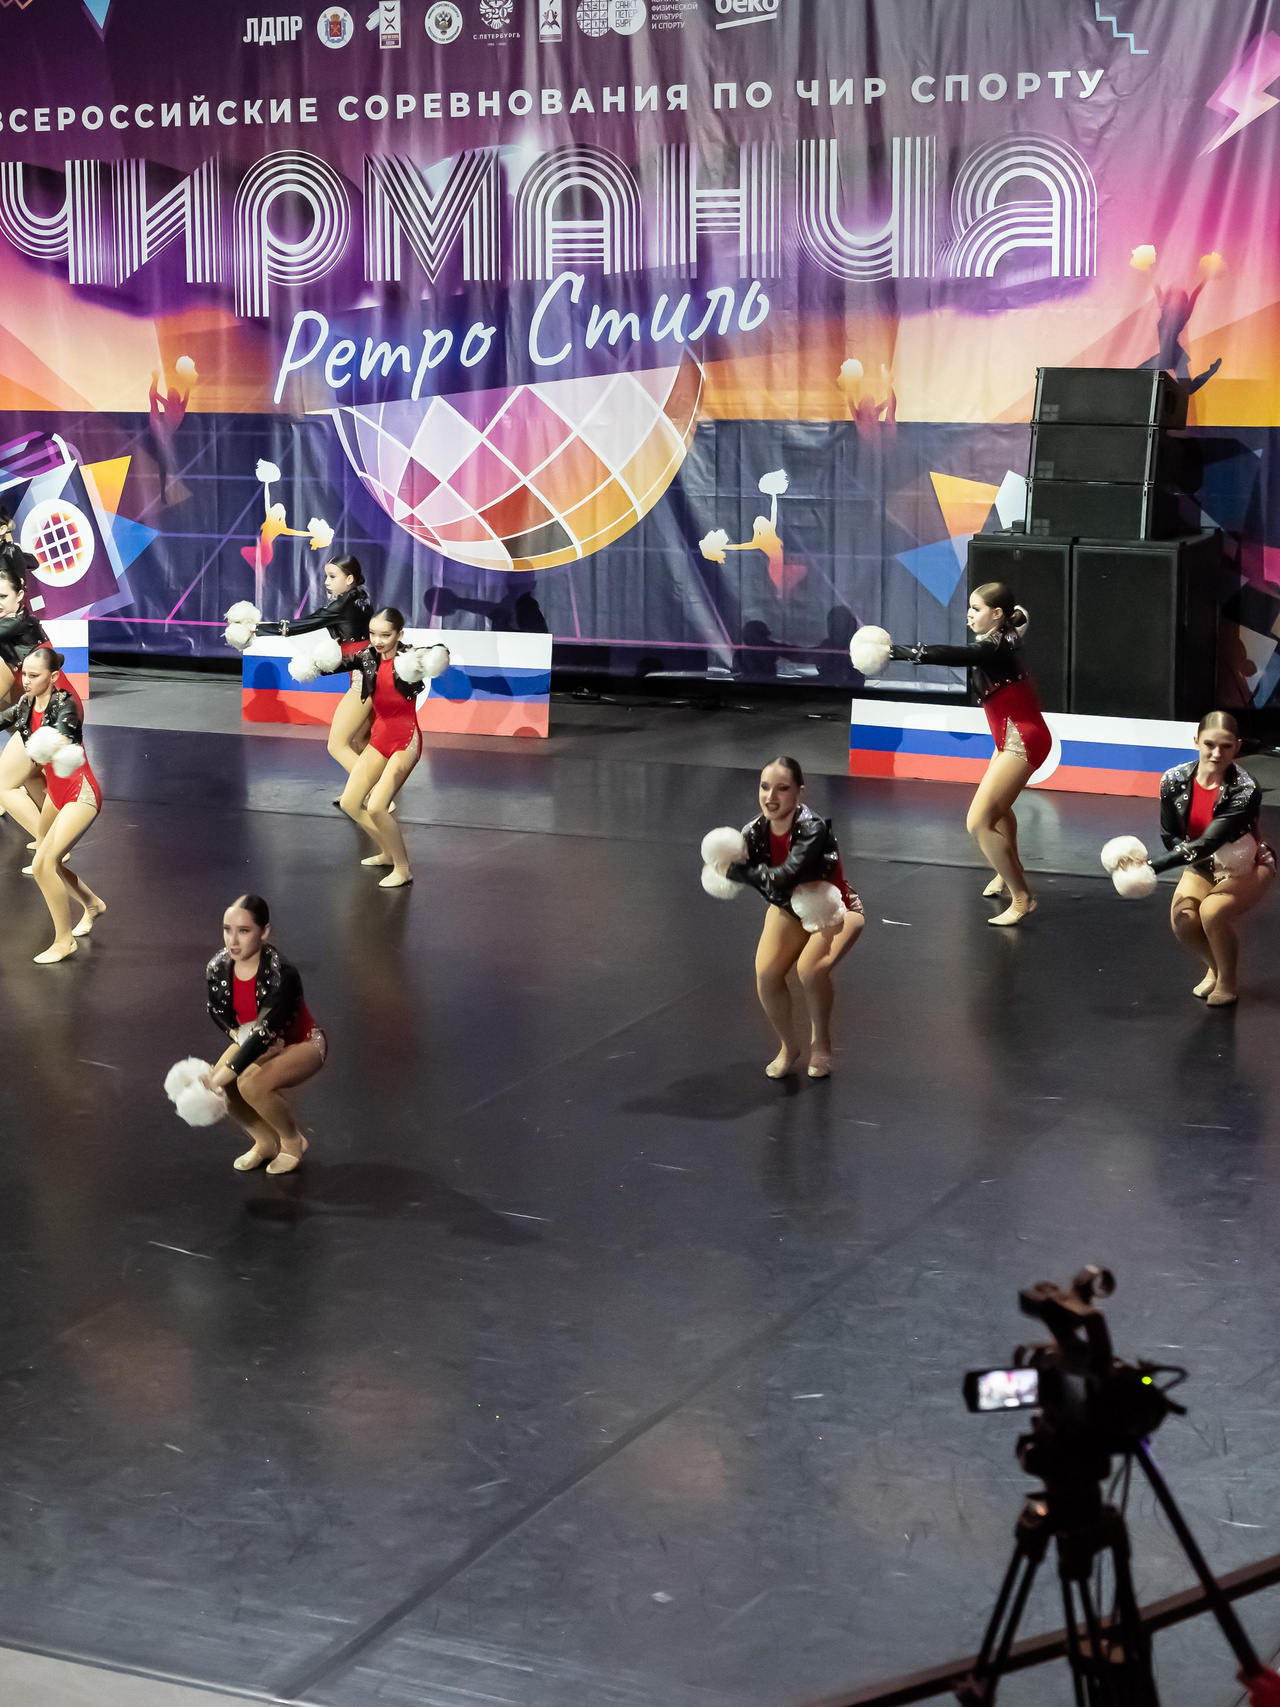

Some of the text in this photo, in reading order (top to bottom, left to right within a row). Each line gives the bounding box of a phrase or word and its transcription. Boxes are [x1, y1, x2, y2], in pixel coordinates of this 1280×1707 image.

[651, 2, 698, 11] ФИЗИЧЕСКОЙ
[243, 16, 303, 46] ЛДПР
[338, 84, 688, 122] СОРЕВНОВАНИЯ
[714, 81, 773, 109] ПО
[797, 77, 887, 106] ЧИР
[911, 69, 1105, 103] СПОРТУ
[273, 271, 771, 405] Ретро Стиль
